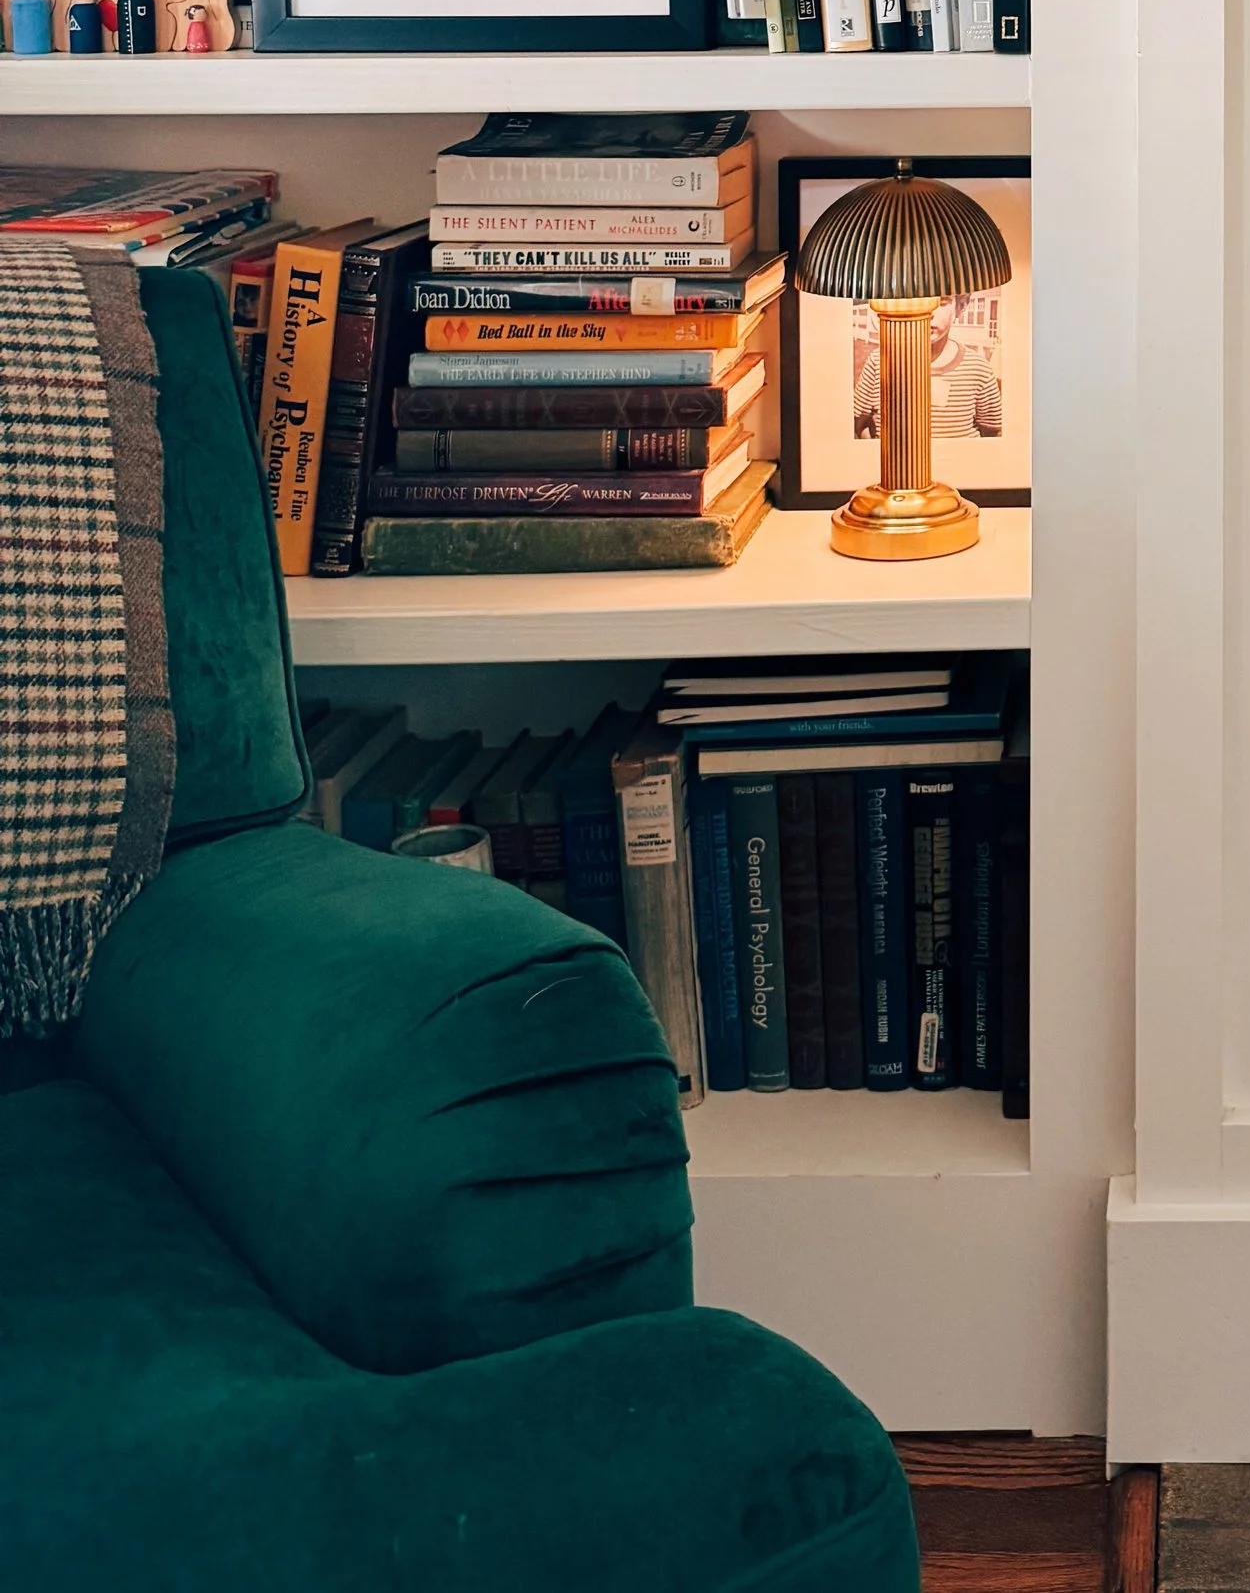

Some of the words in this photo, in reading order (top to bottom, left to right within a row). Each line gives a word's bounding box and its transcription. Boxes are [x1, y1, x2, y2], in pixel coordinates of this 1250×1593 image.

[461, 163, 476, 181] A
[489, 162, 588, 183] LITTLE
[601, 162, 662, 182] LIFE
[443, 217, 469, 229] THE
[478, 217, 527, 230] SILENT
[535, 218, 597, 231] PATIENT
[608, 226, 678, 236] MICHAELIDES
[631, 216, 656, 224] ALEX
[515, 251, 560, 265] CAN'T
[564, 251, 597, 265] KILL
[600, 251, 619, 265] US
[413, 285, 450, 312] Joan
[453, 285, 511, 311] Didion
[275, 265, 323, 369] History
[306, 307, 327, 327] A
[477, 324, 503, 340] Red
[506, 324, 534, 339] Ball
[538, 325, 552, 338] in
[556, 324, 578, 338] the
[581, 324, 607, 341] Sky
[440, 356, 471, 366] Storm
[473, 356, 519, 366] Jameson
[440, 369, 465, 381] THE
[466, 369, 506, 381] EARLY
[511, 369, 538, 381] LIFE
[541, 369, 554, 381] OF
[562, 368, 618, 381] STEPHEN
[621, 368, 651, 381] HIND
[272, 371, 291, 393] of
[294, 430, 315, 485] Reuben
[290, 489, 308, 522] Fine
[378, 487, 400, 498] THE
[405, 486, 467, 501] PURPOSE
[529, 482, 579, 512] Life
[582, 489, 632, 500] WARREN
[789, 720, 811, 732] with
[813, 722, 836, 734] your
[867, 787, 887, 844] Perfect
[747, 836, 771, 915] General
[868, 844, 888, 899] Weight
[974, 840, 994, 899] Bridges
[873, 904, 886, 955] AMERICA
[973, 904, 990, 959] London
[720, 951, 738, 1021] DOCTOR
[750, 922, 775, 1029] Psychology
[875, 977, 888, 1012] JORDAN
[976, 969, 988, 1033] PATTERSON
[877, 1013, 889, 1044] RUBIN
[975, 1037, 987, 1069] JAMES
